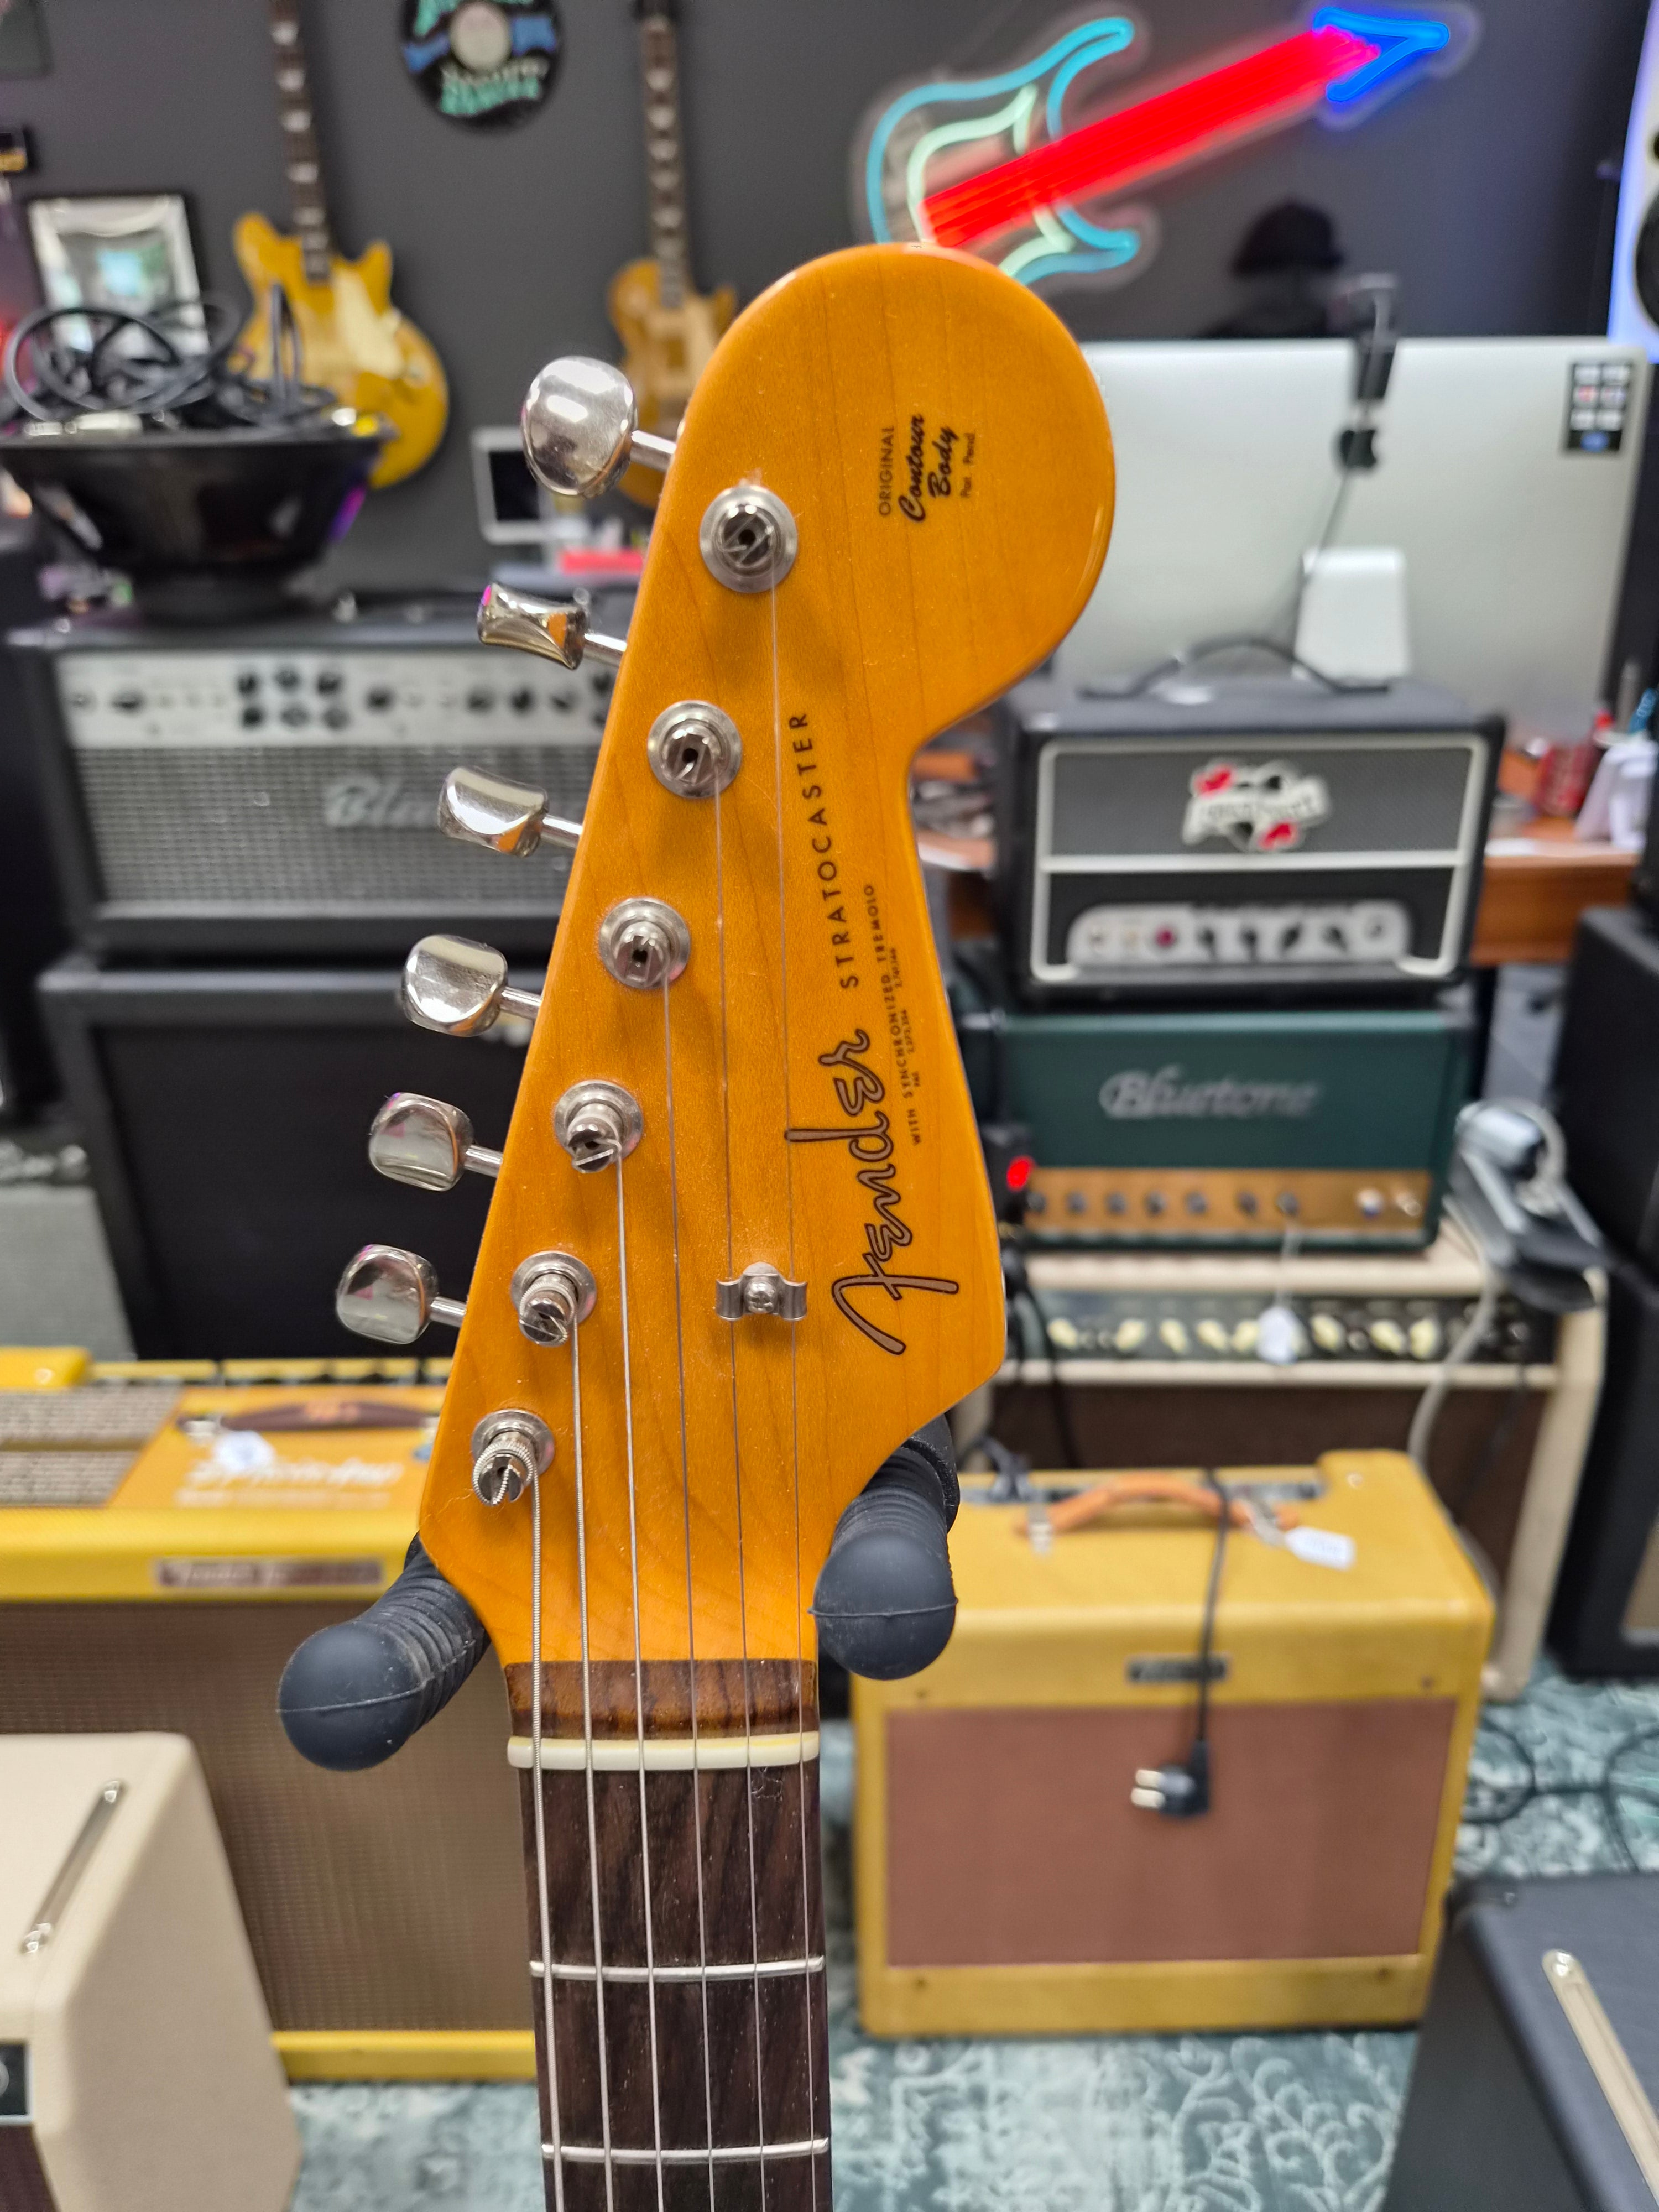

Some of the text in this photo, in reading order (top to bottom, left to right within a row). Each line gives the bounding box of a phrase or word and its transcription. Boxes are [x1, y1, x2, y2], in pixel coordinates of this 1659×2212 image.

[879, 425, 894, 515] ORIGINAL
[898, 414, 926, 522] Contour
[927, 426, 959, 498] Body
[784, 714, 959, 1355] Fender STRATOCASTER
[864, 885, 921, 1145] WITH SYNCHRONIZED TREMOLO
